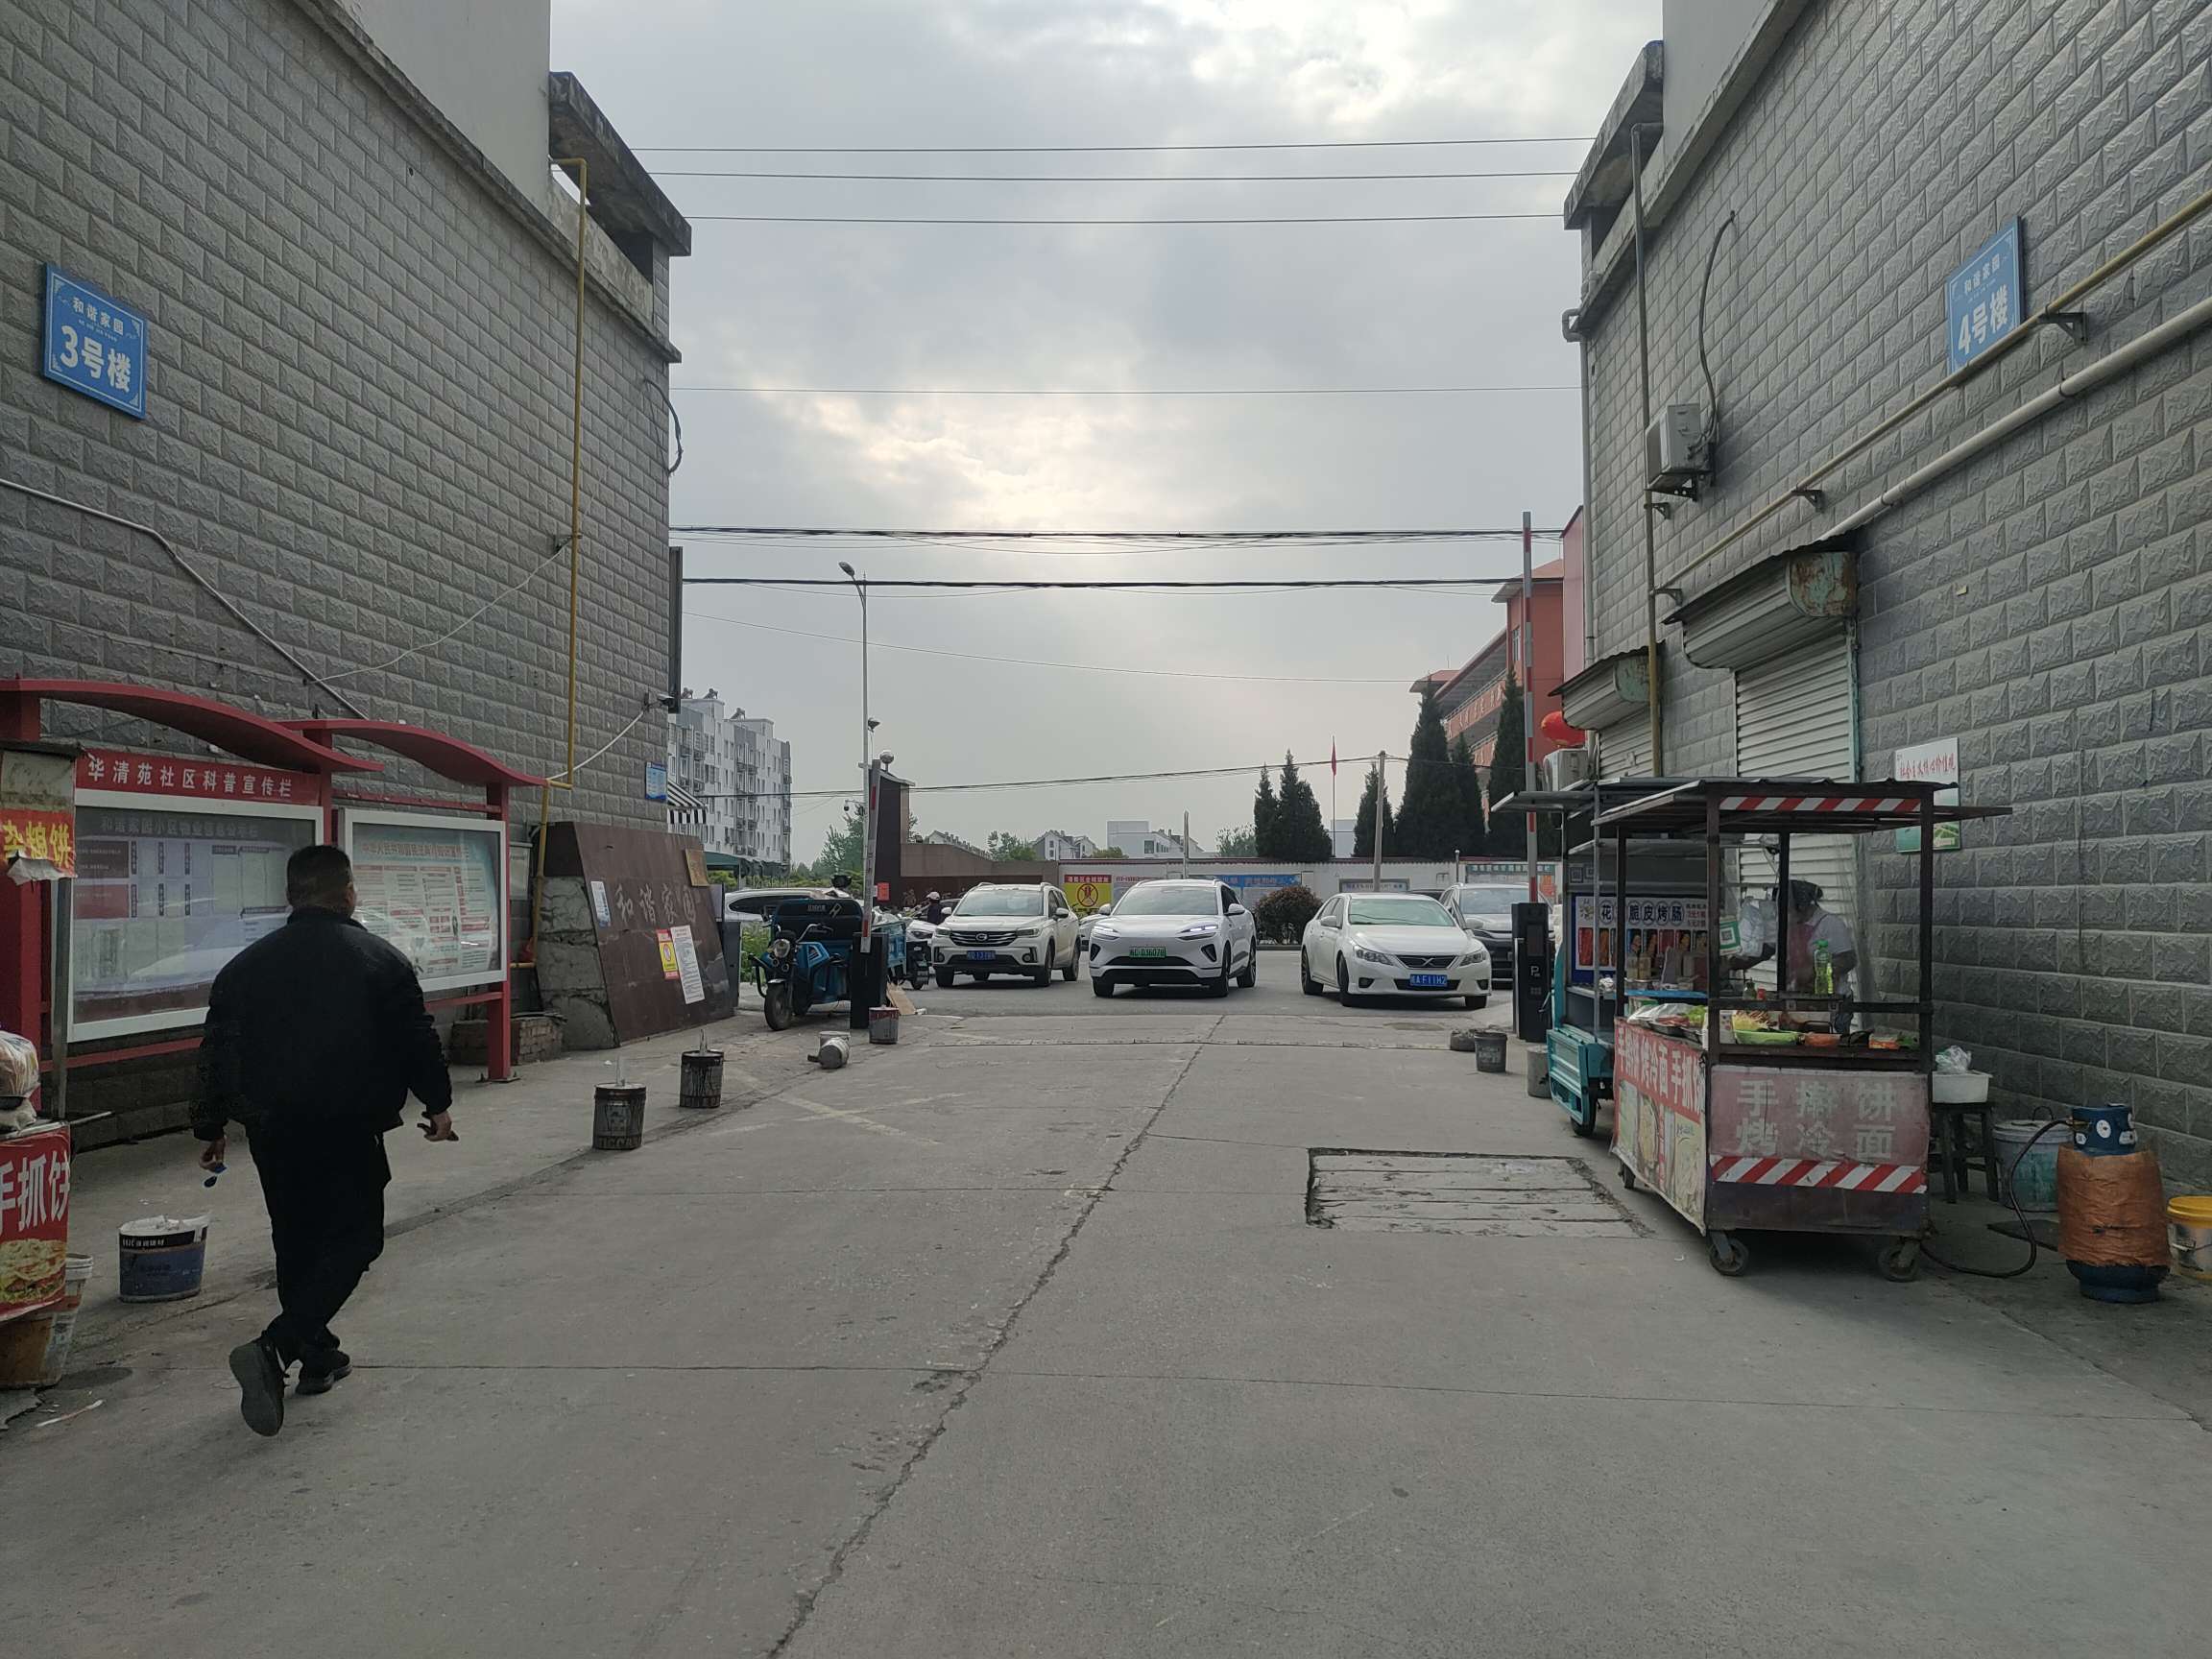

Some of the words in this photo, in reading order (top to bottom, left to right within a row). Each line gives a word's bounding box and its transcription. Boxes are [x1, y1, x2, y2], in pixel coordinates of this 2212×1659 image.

[1958, 284, 2008, 355] 4号楼
[60, 325, 132, 393] 3号楼
[87, 754, 292, 797] 华清苑社区科普宣传栏
[1600, 904, 1682, 923] 花脆皮烤肠
[1736, 1118, 1896, 1160] 烤冷面
